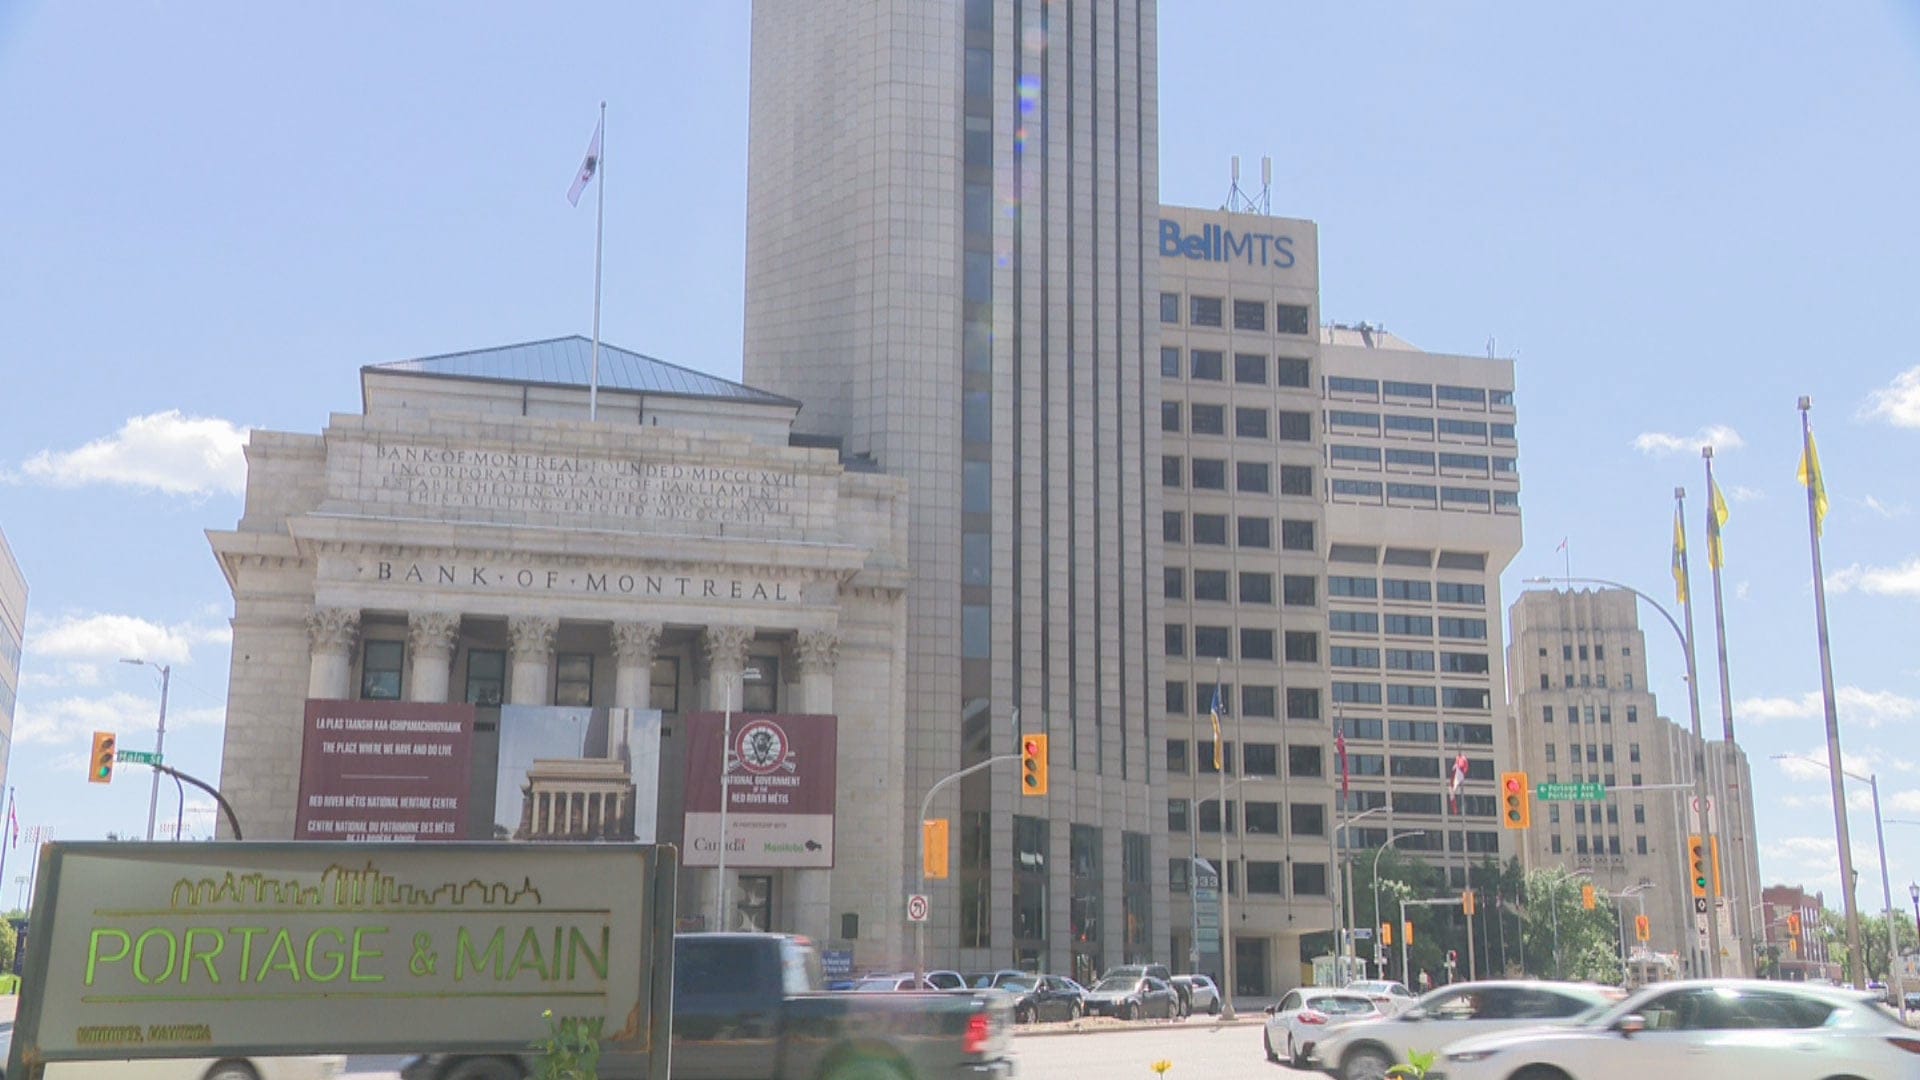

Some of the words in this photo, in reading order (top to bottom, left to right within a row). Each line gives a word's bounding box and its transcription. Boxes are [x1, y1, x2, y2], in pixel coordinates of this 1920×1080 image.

[377, 445, 437, 463] BANK
[442, 450, 466, 464] OF
[474, 452, 583, 472] MONTREAL
[592, 461, 683, 478] FOUNDED
[391, 462, 546, 484] INCORPORATED
[629, 478, 652, 490] OF
[662, 480, 784, 499] PARLIAMENT
[378, 561, 487, 585] BANK
[517, 569, 558, 588] OF
[586, 573, 787, 602] MONTREAL
[323, 742, 336, 753] THE
[337, 742, 357, 753] PLACE
[359, 742, 381, 755] WHERE
[383, 743, 394, 755] WE
[395, 743, 412, 755] HAVE
[413, 743, 427, 755] AND
[438, 744, 452, 756] LIVE
[84, 926, 389, 986] PORTAGE
[409, 930, 438, 976] &
[455, 926, 609, 982] MAIN
